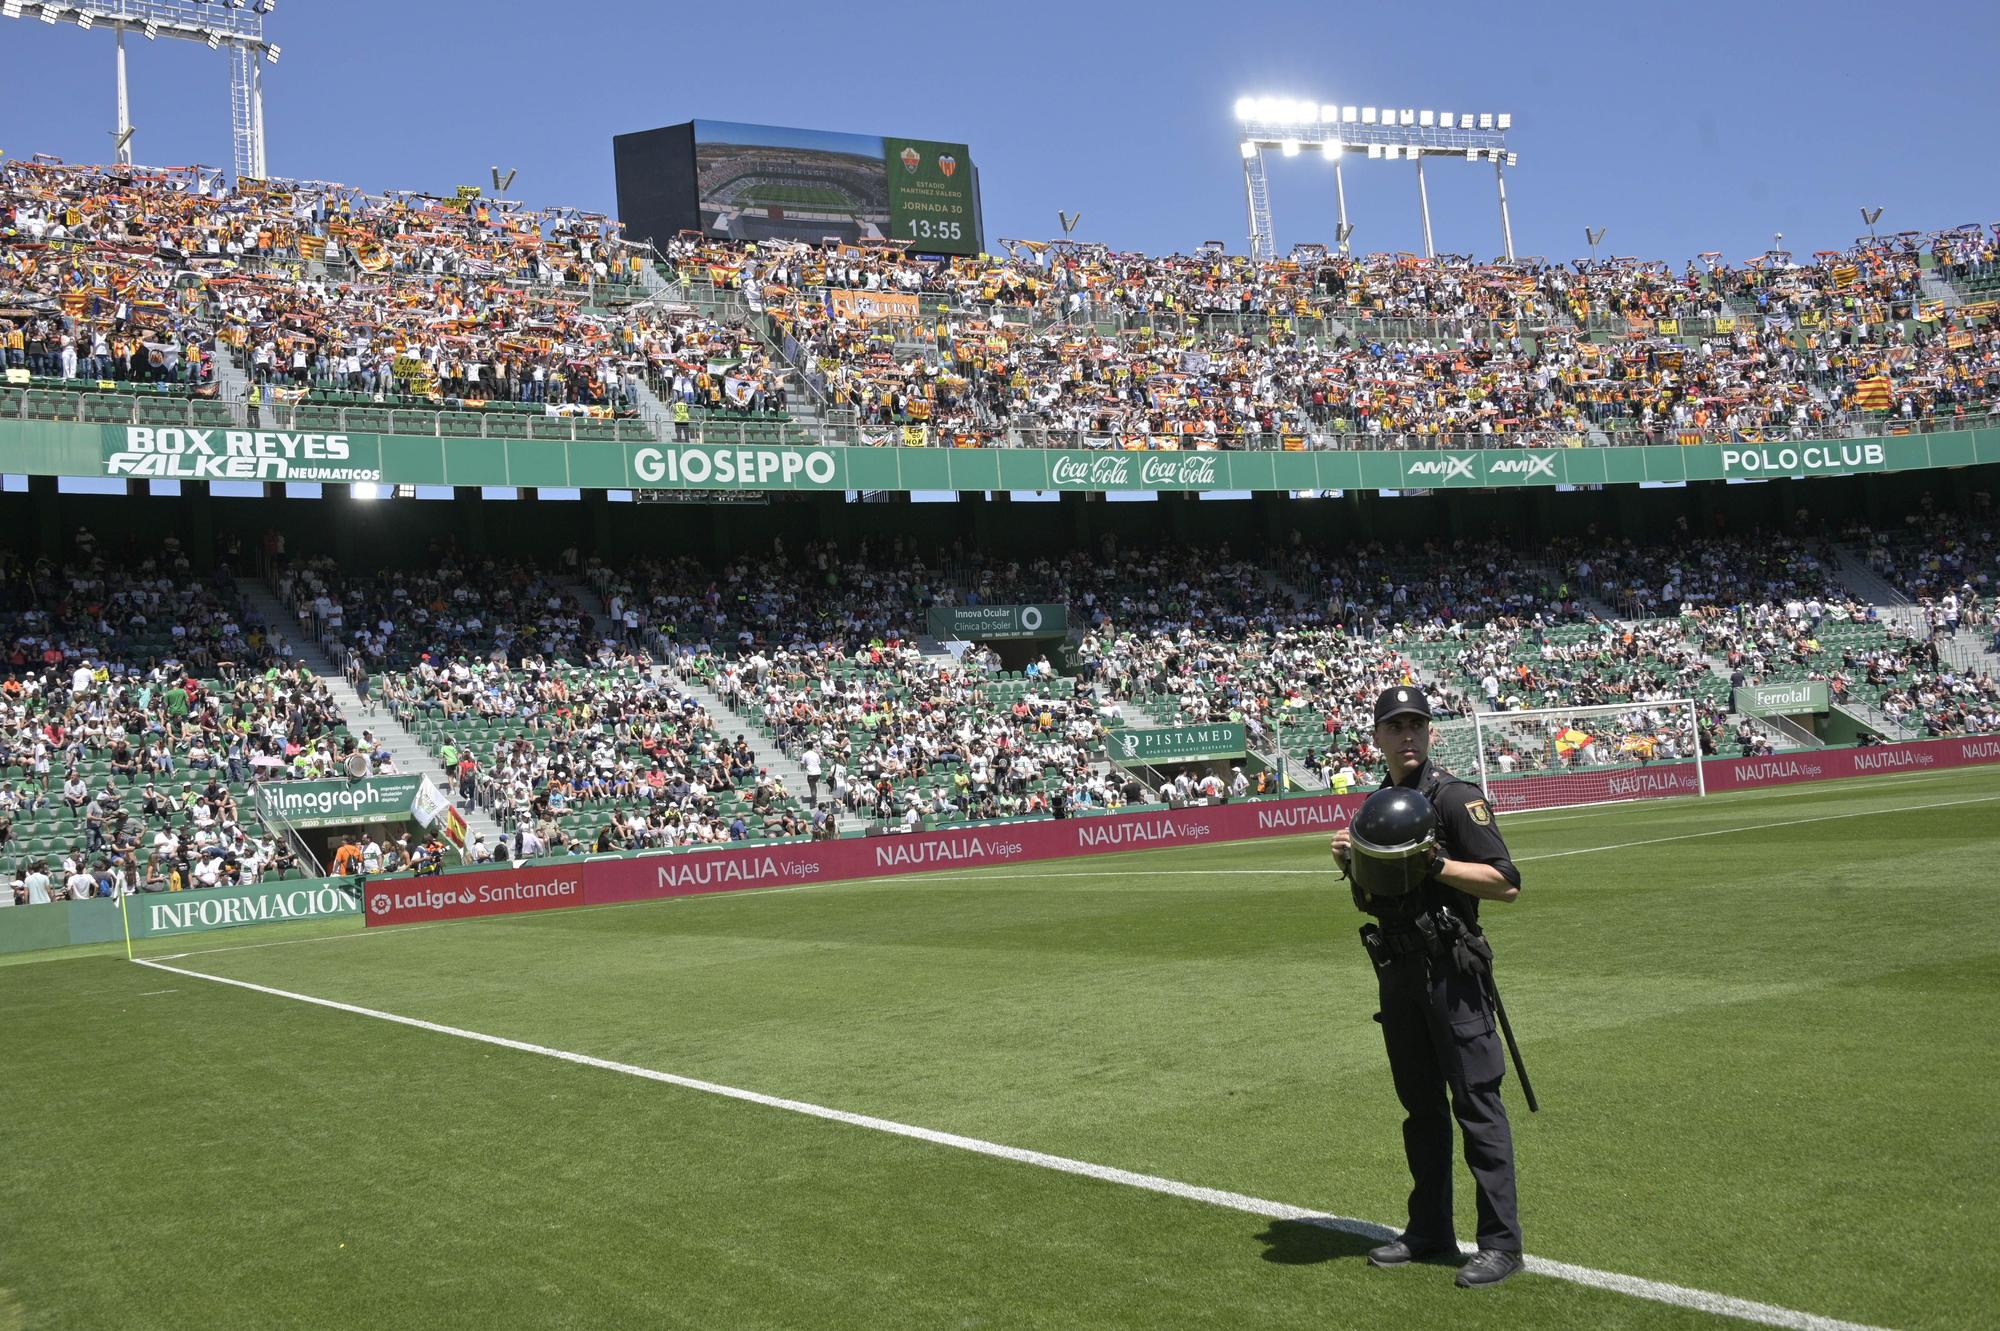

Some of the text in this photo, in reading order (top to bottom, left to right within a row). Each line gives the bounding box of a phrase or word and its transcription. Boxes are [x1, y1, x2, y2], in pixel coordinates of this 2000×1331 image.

[916, 181, 945, 190] ESTADIO
[936, 190, 962, 198] VALERO
[902, 201, 963, 214] JORNADA 30
[908, 219, 961, 240] 13:55
[399, 358, 418, 366] LIM
[127, 427, 349, 460] BOX REYES
[103, 452, 380, 481] FALKEN NEUMATICOS
[634, 448, 835, 484] GIOSEPPO
[1407, 453, 1477, 482] AMIX
[1489, 451, 1558, 481] AMIX
[1723, 444, 1884, 471] POLO CLUB
[955, 608, 1010, 619] Innova Ocular
[1145, 729, 1233, 746] PISTAMED
[1735, 761, 1822, 782] NAUTALIA Viajes
[1854, 750, 1934, 770] NAUTALIA Viajes
[1609, 773, 1679, 795] NAUTALIA
[1258, 803, 1346, 829] NAUTALIA
[1078, 819, 1210, 847] NAUTALIA Viajes
[875, 837, 1023, 867] NAUTALIA Viajes
[657, 856, 820, 888] NAUTALIA Viajes
[150, 883, 358, 931] INFORMACIÓN
[395, 879, 578, 910] LaLiga Santander
